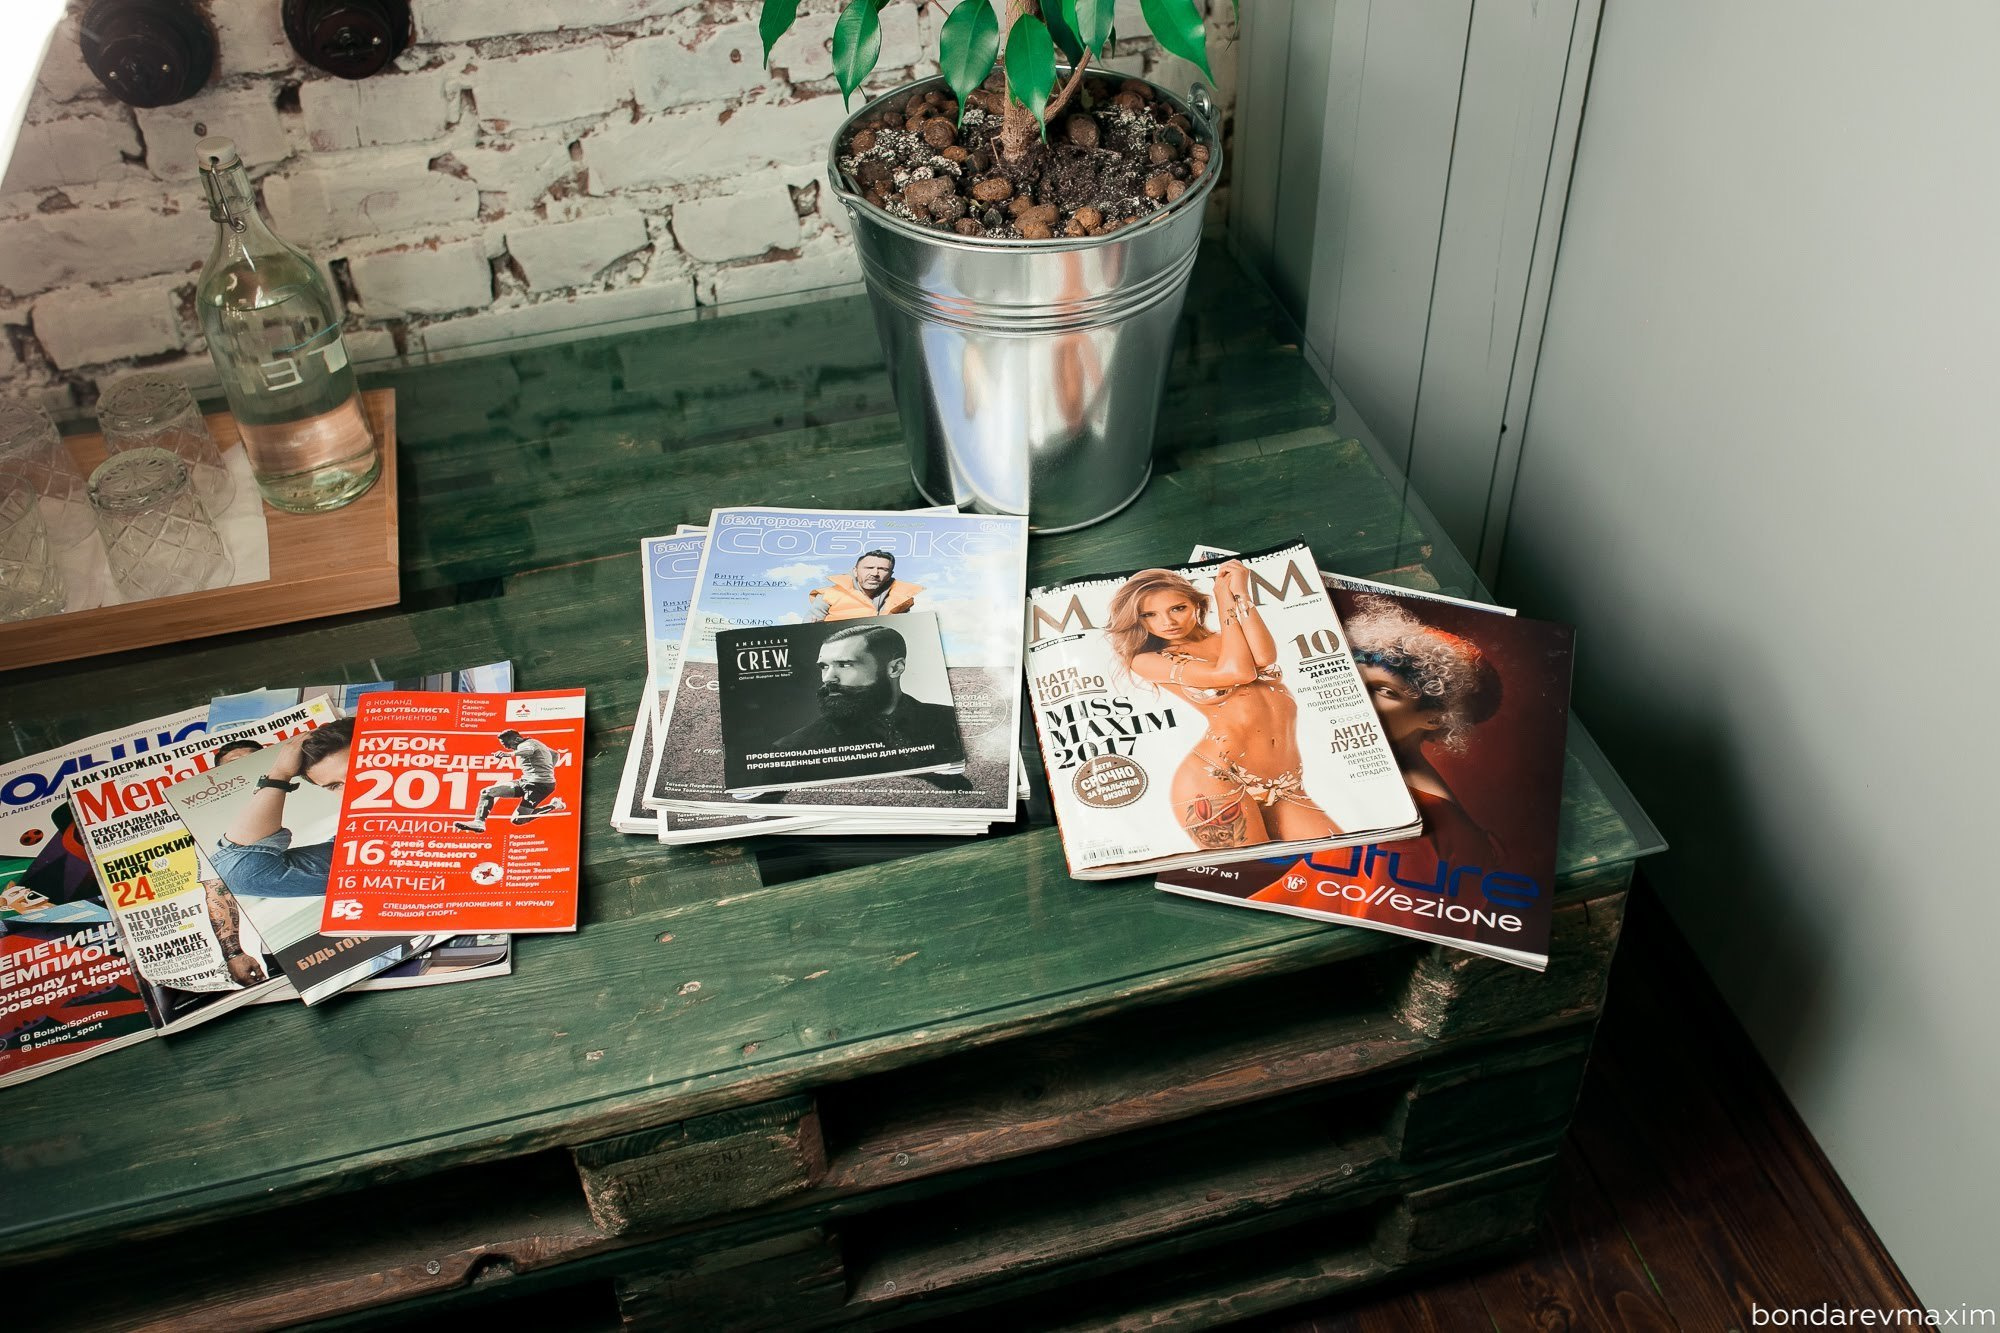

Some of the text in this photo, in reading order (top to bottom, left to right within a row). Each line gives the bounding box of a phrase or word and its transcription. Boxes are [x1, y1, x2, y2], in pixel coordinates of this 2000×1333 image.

[735, 638, 788, 647] AMERICAN
[1288, 629, 1340, 660] 10
[1035, 666, 1079, 689] КАТЯ
[1299, 662, 1325, 674] ХОТЯ
[1310, 665, 1351, 679] ДЕВЯТЬ
[1297, 677, 1356, 694] ДЛЯ ВЫЯВЛЕНИЯ
[1315, 672, 1353, 684] ВОПРОСОВ
[1039, 675, 1105, 701] КОТАРО
[1316, 682, 1359, 700] ТВОЕЙ
[1307, 692, 1362, 707] ПОЛИТИЧЕСКОЙ
[1319, 699, 1365, 713] ОРИЕНТАЦИИ
[1046, 696, 1134, 729] MISS
[1050, 708, 1179, 749] MAXIM
[1333, 721, 1377, 740] АНТИ-
[70, 772, 98, 789] КАК
[101, 752, 171, 779] УДЕРЖАТЬ
[172, 728, 258, 759] ТЕСТОСТЕРОН
[258, 724, 267, 734] В
[267, 708, 309, 730] НОРМЕ
[358, 736, 447, 752] КУБОК
[746, 742, 886, 761] ПРОФЕССИОНАЛЬНЫЕ ПРОДУКТЫ,
[1054, 736, 1137, 770] 2017
[1330, 733, 1379, 754] ЛУЗЕР
[1342, 746, 1384, 760] КАК НАЧАТЬ
[355, 749, 572, 772] КОНФЕДЕРАЙ
[746, 744, 935, 770] ПРОИЗВЕДЕННЫЕ СПЕЦИАЛЬНО ДЛЯ МУЖЧИН
[1347, 753, 1386, 766] ПЕРЕСТАТЬ
[1358, 760, 1389, 771] ТЕРПЕТЬ
[1080, 766, 1136, 791] СРОЧНО
[1356, 765, 1391, 778] СТРАДАТЬ
[1086, 778, 1140, 799] ЗА УРАЛЬСКОЙ
[1103, 788, 1131, 801] ВИЗОЙ!
[90, 809, 168, 838] СЕКСУАЛЬНАЯ
[346, 820, 474, 834] 4 СТАДИОН
[93, 828, 130, 846] КАРТА
[102, 833, 196, 873] БИЦЕПСКИЙ
[342, 839, 493, 867] 16 дней большого
[390, 849, 478, 859] футбольного
[107, 862, 152, 884] ПАРК
[388, 859, 461, 869] праздника
[112, 875, 156, 908] 24
[337, 875, 446, 891] 16 МАТЧЕЙ
[1286, 876, 1306, 890] 16+
[124, 902, 178, 921] ЧТО НАС
[383, 902, 444, 910] СПЕЦИАЛЬНОЕ
[446, 900, 504, 908] ПРИЛОЖЕНИЕ
[129, 919, 148, 932] НЕ
[148, 903, 203, 929] УБИВАЕТ
[131, 930, 144, 938] КАК
[144, 920, 182, 935] ВЫУЧИТЬСЯ
[160, 929, 176, 937] БОЛЬ
[137, 932, 204, 957] ЗА НАМИ НЕ
[141, 938, 209, 964] ЗАРЖАВЕЕТ
[296, 948, 336, 971] БУДЬ
[71, 970, 84, 981] и
[33, 1009, 109, 1039] BolshoiSportRu
[35, 1022, 103, 1049] bolshoi_sport
